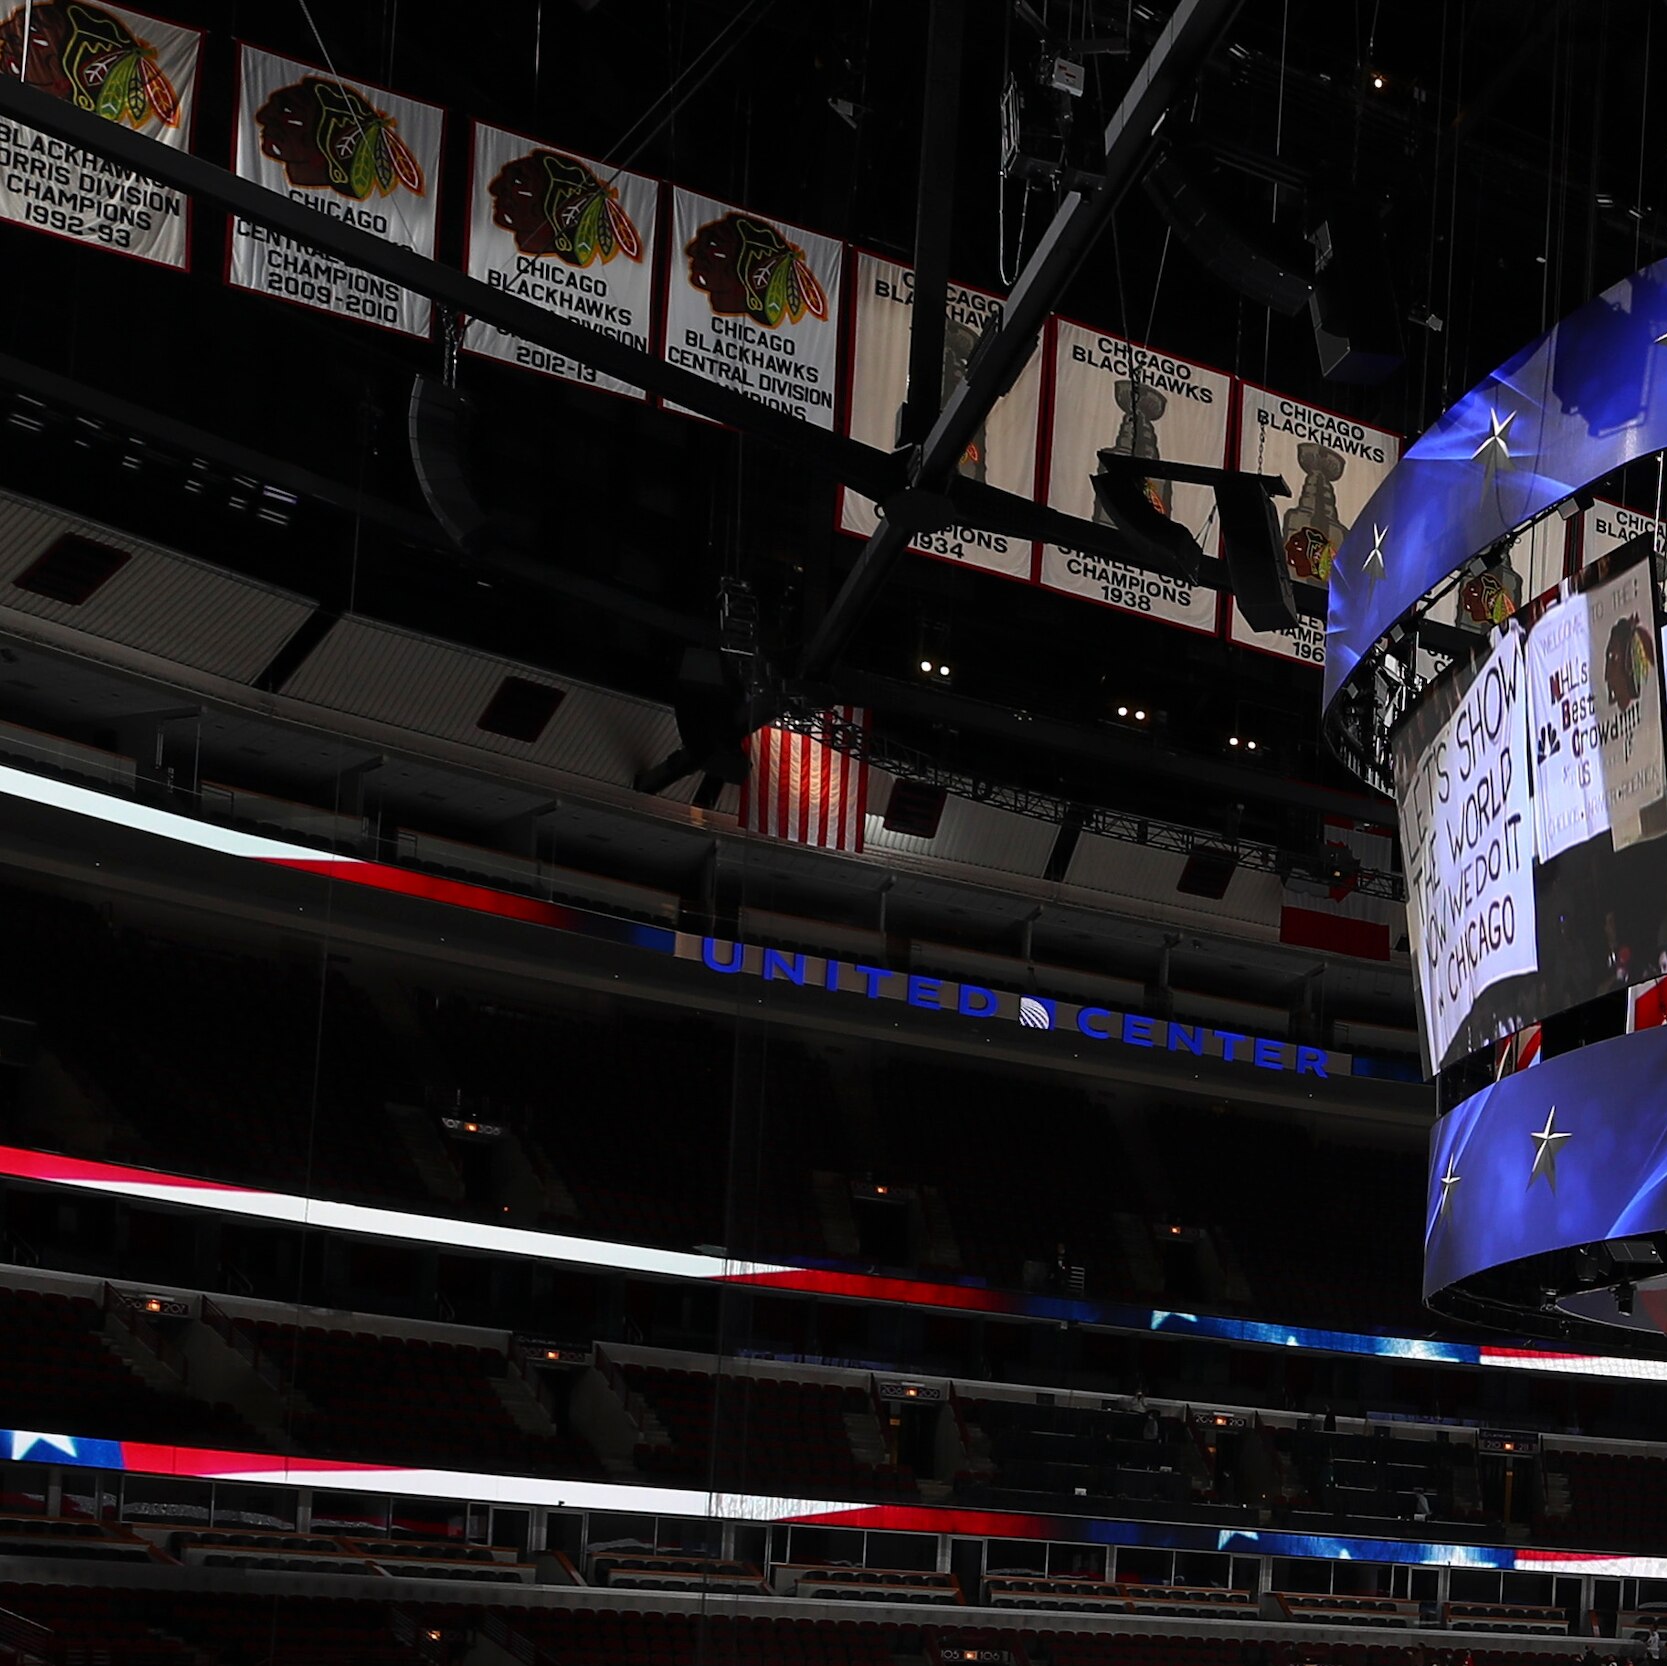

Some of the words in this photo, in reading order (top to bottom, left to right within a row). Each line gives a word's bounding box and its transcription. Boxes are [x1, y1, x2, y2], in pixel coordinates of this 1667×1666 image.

[7, 174, 152, 231] CHAMPIONS
[80, 174, 181, 217] DIVISION
[26, 203, 130, 248] 1992-93
[268, 250, 400, 303] CHAMPIONS
[269, 273, 398, 324] 2009-2010
[488, 269, 633, 326] BLACKHAWKS
[516, 256, 607, 297] CHICAGO
[685, 330, 819, 383] BLACKHAWKS
[711, 317, 795, 356] CHICAGO
[1098, 337, 1192, 380] CHICAGO
[516, 346, 597, 383] 2012-13
[668, 347, 753, 387] CENTRAL
[759, 374, 833, 409] DIVISION
[1073, 345, 1214, 404] BLACKHAWKS
[1257, 408, 1385, 463] BLACKHAWKS
[1280, 401, 1365, 441] CHICAGO
[1067, 559, 1192, 607] CHAMPIONS
[1102, 586, 1151, 612] 1938
[1455, 653, 1519, 781] SHOW
[1561, 694, 1595, 732] Best
[1446, 747, 1513, 864] WORLD
[1449, 895, 1515, 1003] CHICAGO
[701, 936, 1000, 1019] UNITED
[1077, 1006, 1330, 1079] CENTER
